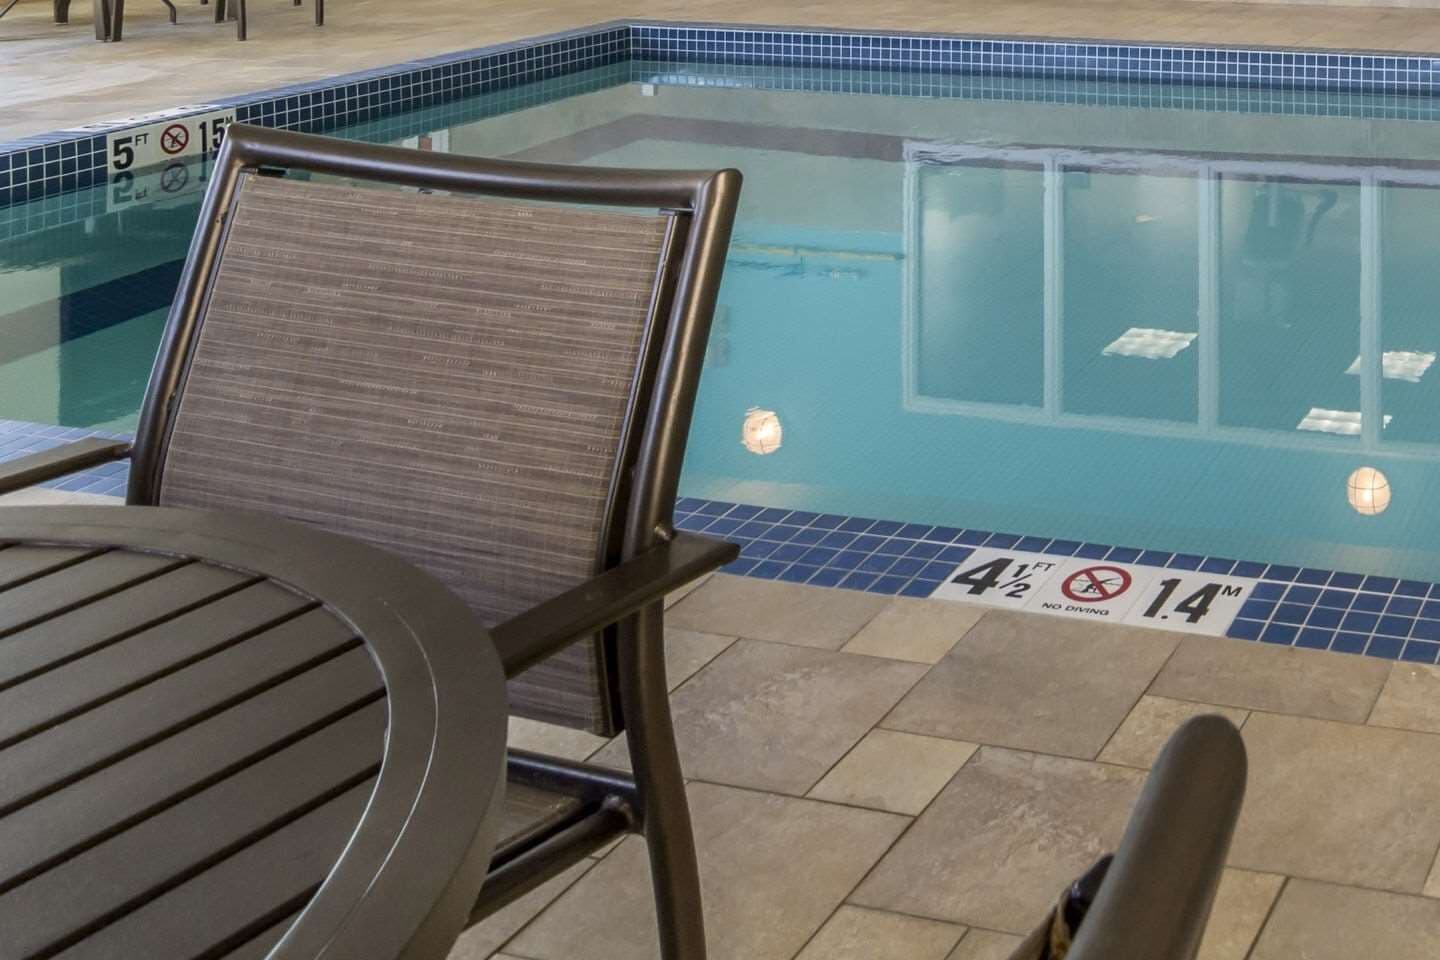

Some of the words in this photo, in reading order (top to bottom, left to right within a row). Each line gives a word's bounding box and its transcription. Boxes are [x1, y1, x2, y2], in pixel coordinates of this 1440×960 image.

[112, 136, 135, 170] 5
[135, 133, 150, 146] FT
[1032, 561, 1057, 572] FT
[1041, 602, 1062, 611] NO
[1064, 604, 1110, 616] DIVING
[1142, 578, 1223, 624] 1.4
[1220, 584, 1243, 597] M
